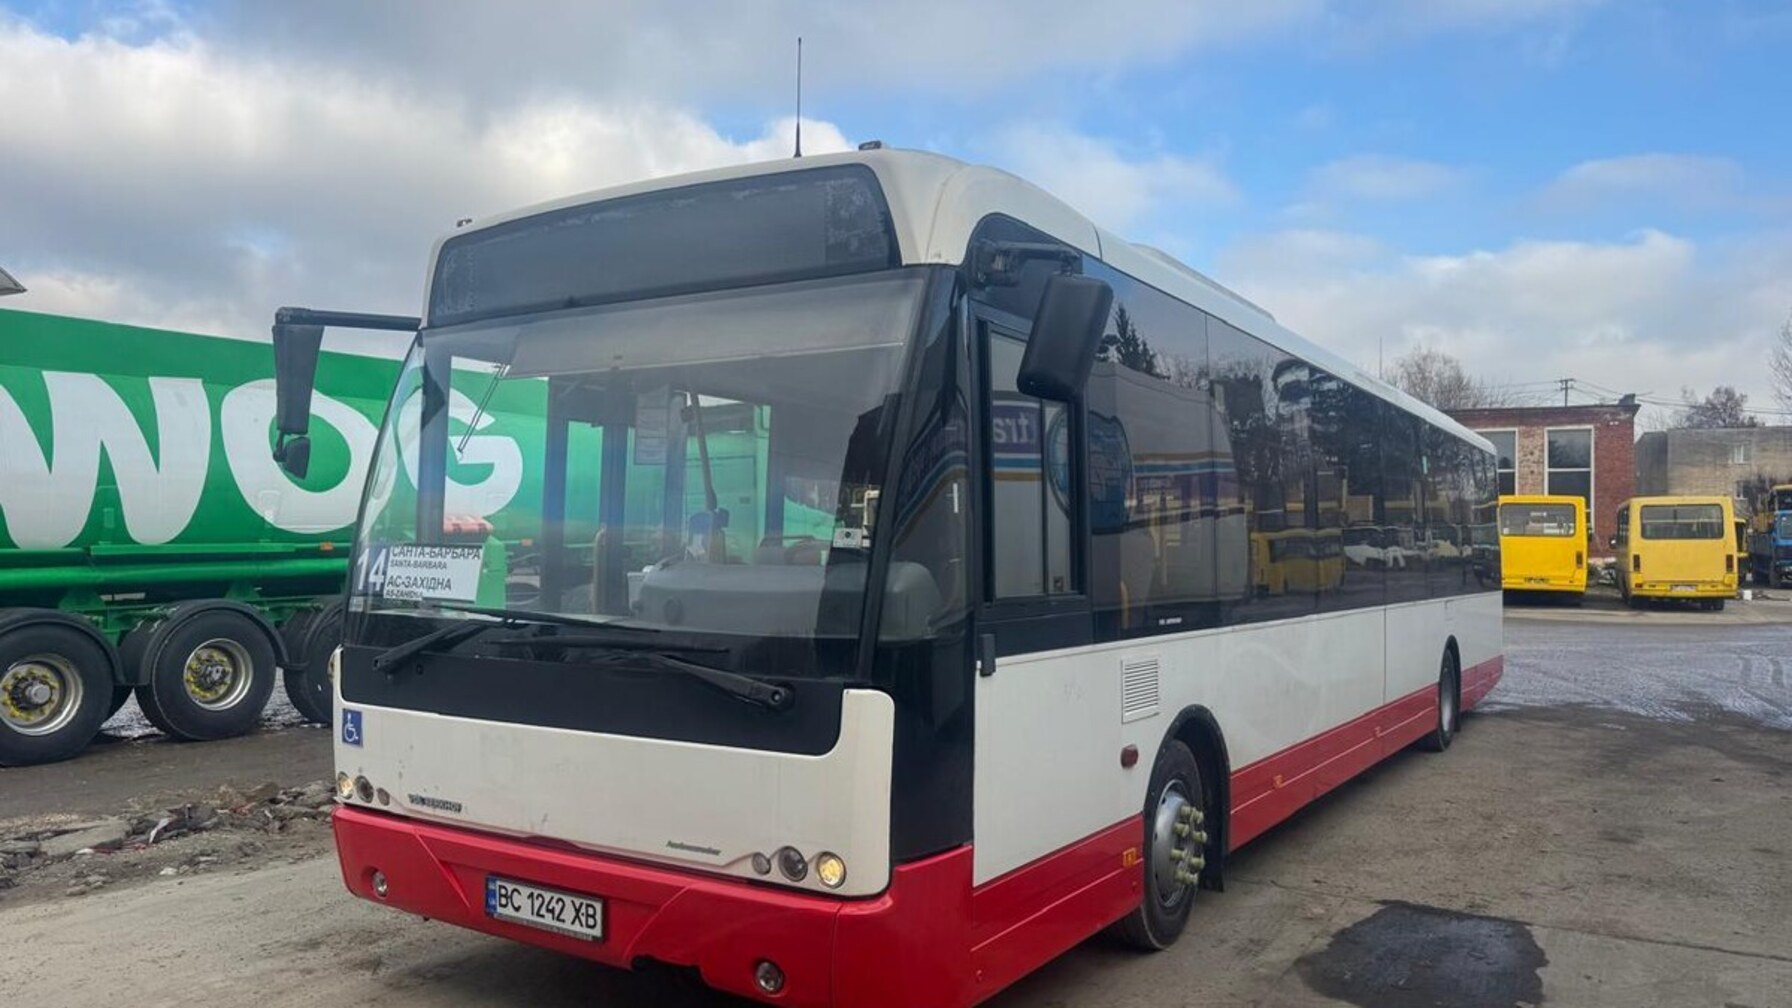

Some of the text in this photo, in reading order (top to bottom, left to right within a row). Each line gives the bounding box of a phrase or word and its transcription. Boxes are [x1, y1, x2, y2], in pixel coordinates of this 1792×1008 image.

[0, 371, 523, 548] WOG
[390, 560, 448, 570] SANTA-BARBARA
[391, 546, 481, 560] САНТА-БАРБАРА
[357, 548, 387, 592] 14
[386, 575, 452, 591] АС-ЗАХІДНА
[498, 884, 598, 929] BC 1242 XB
